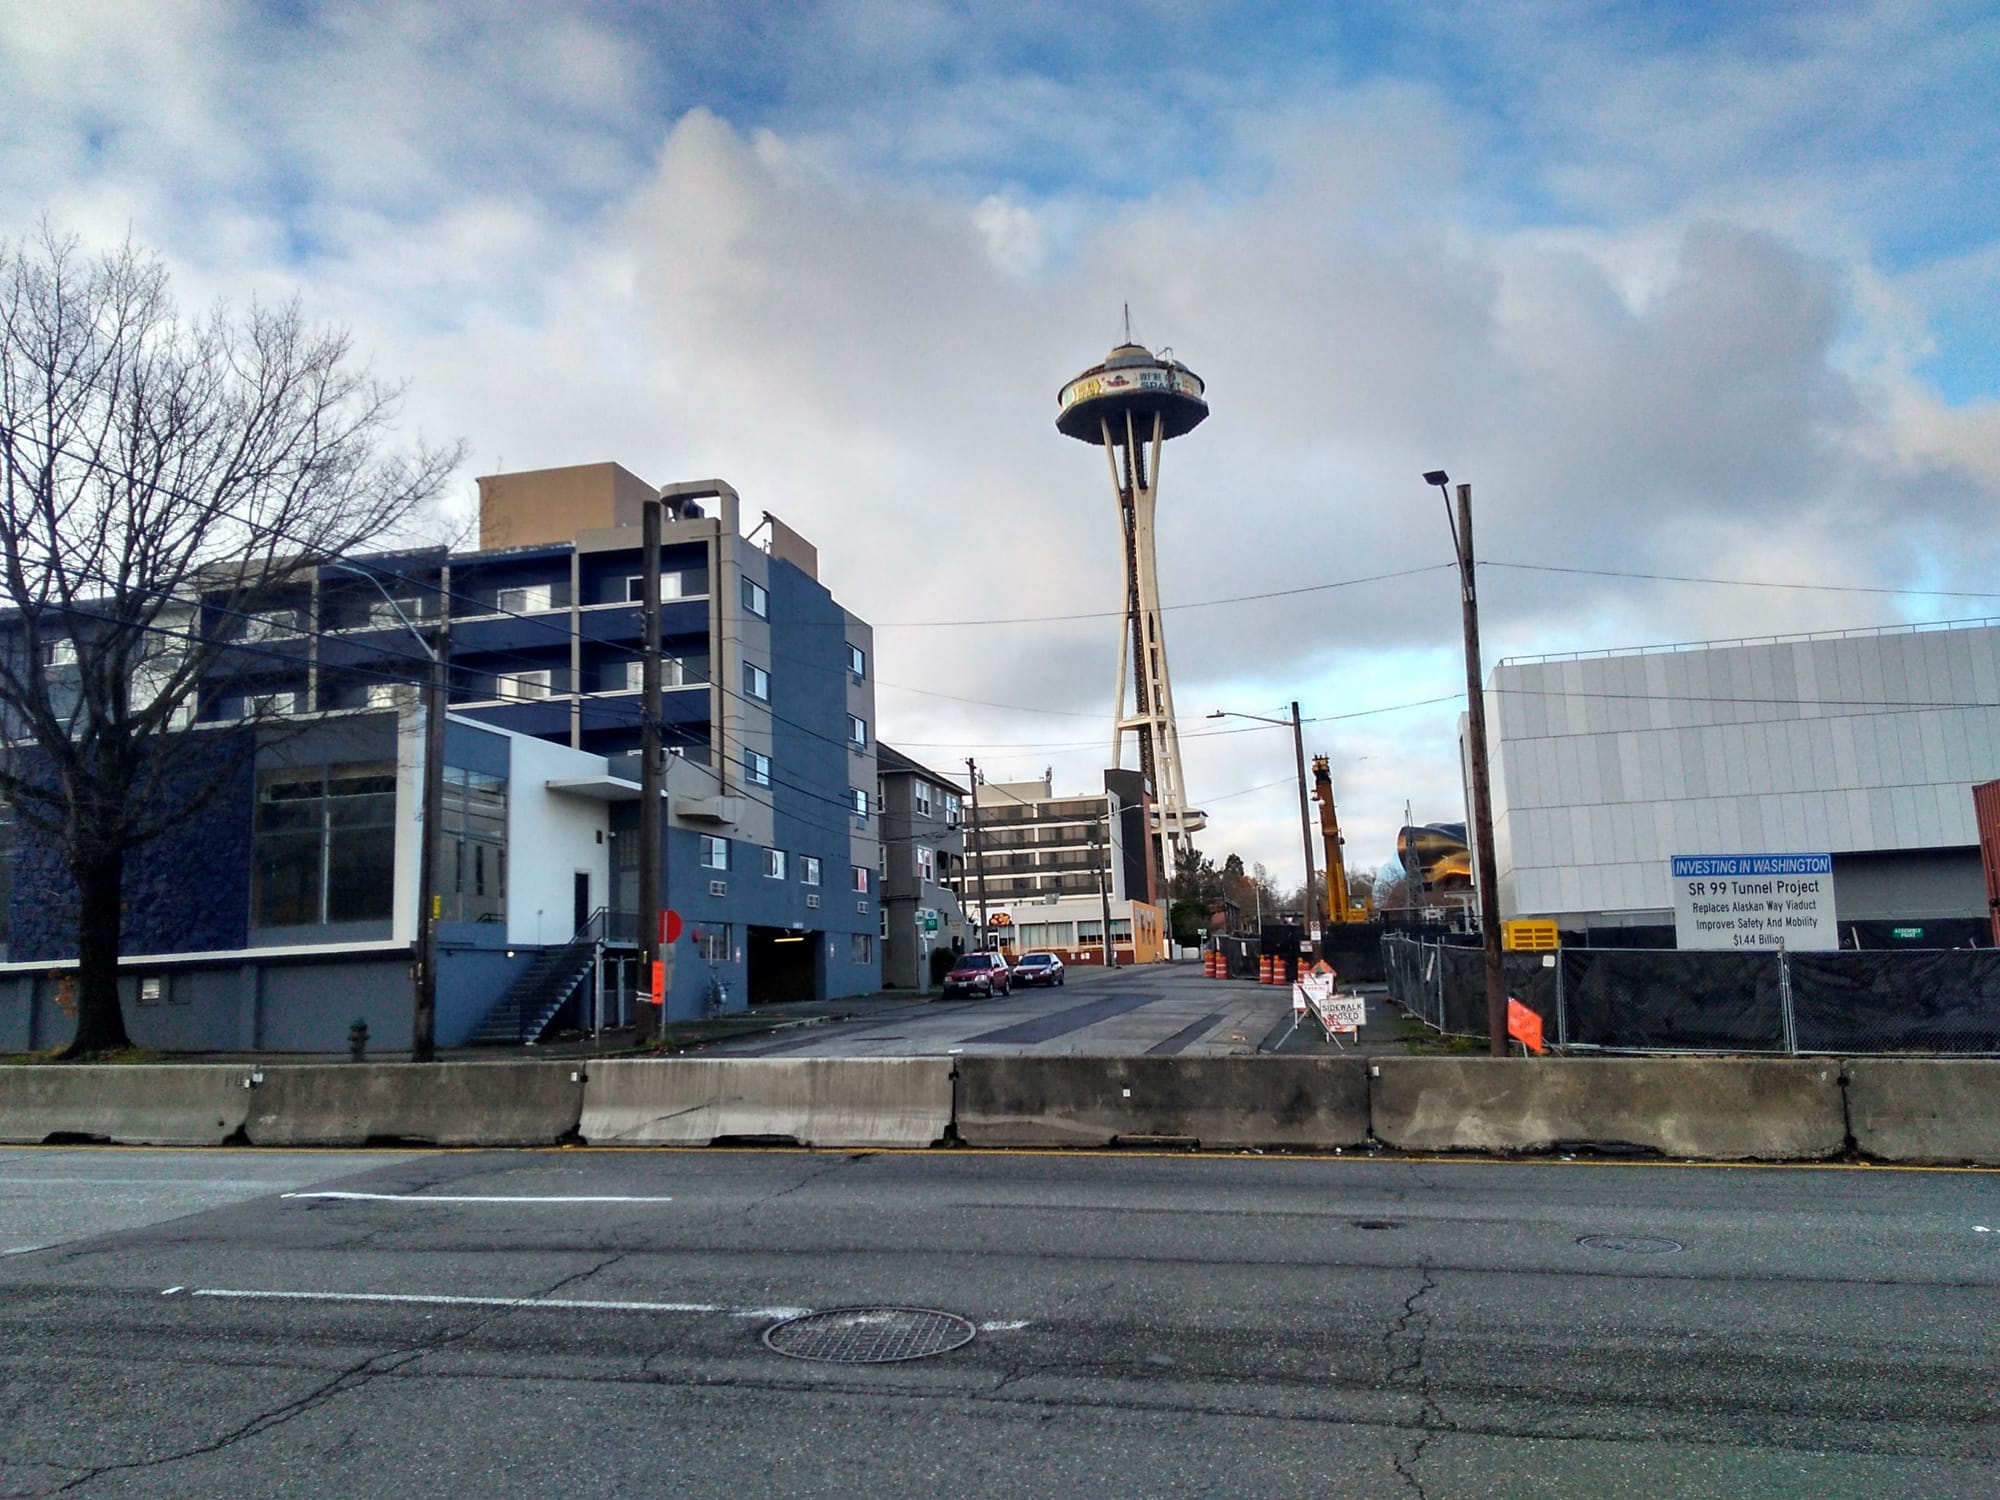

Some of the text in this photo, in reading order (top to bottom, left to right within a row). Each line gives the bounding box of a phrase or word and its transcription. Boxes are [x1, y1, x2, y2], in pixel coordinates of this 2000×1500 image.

[1676, 858, 1828, 875] INVESTING IN WASHINGTON
[1688, 880, 1820, 897] SR 99 Tunnel Project
[1692, 899, 1817, 915] Replaces Alaskan Way Viaduct
[1696, 916, 1818, 932] Improves Safety And Mobility
[1733, 934, 1785, 947] $1.44 Billion
[1321, 1003, 1362, 1012] SIDEWALK
